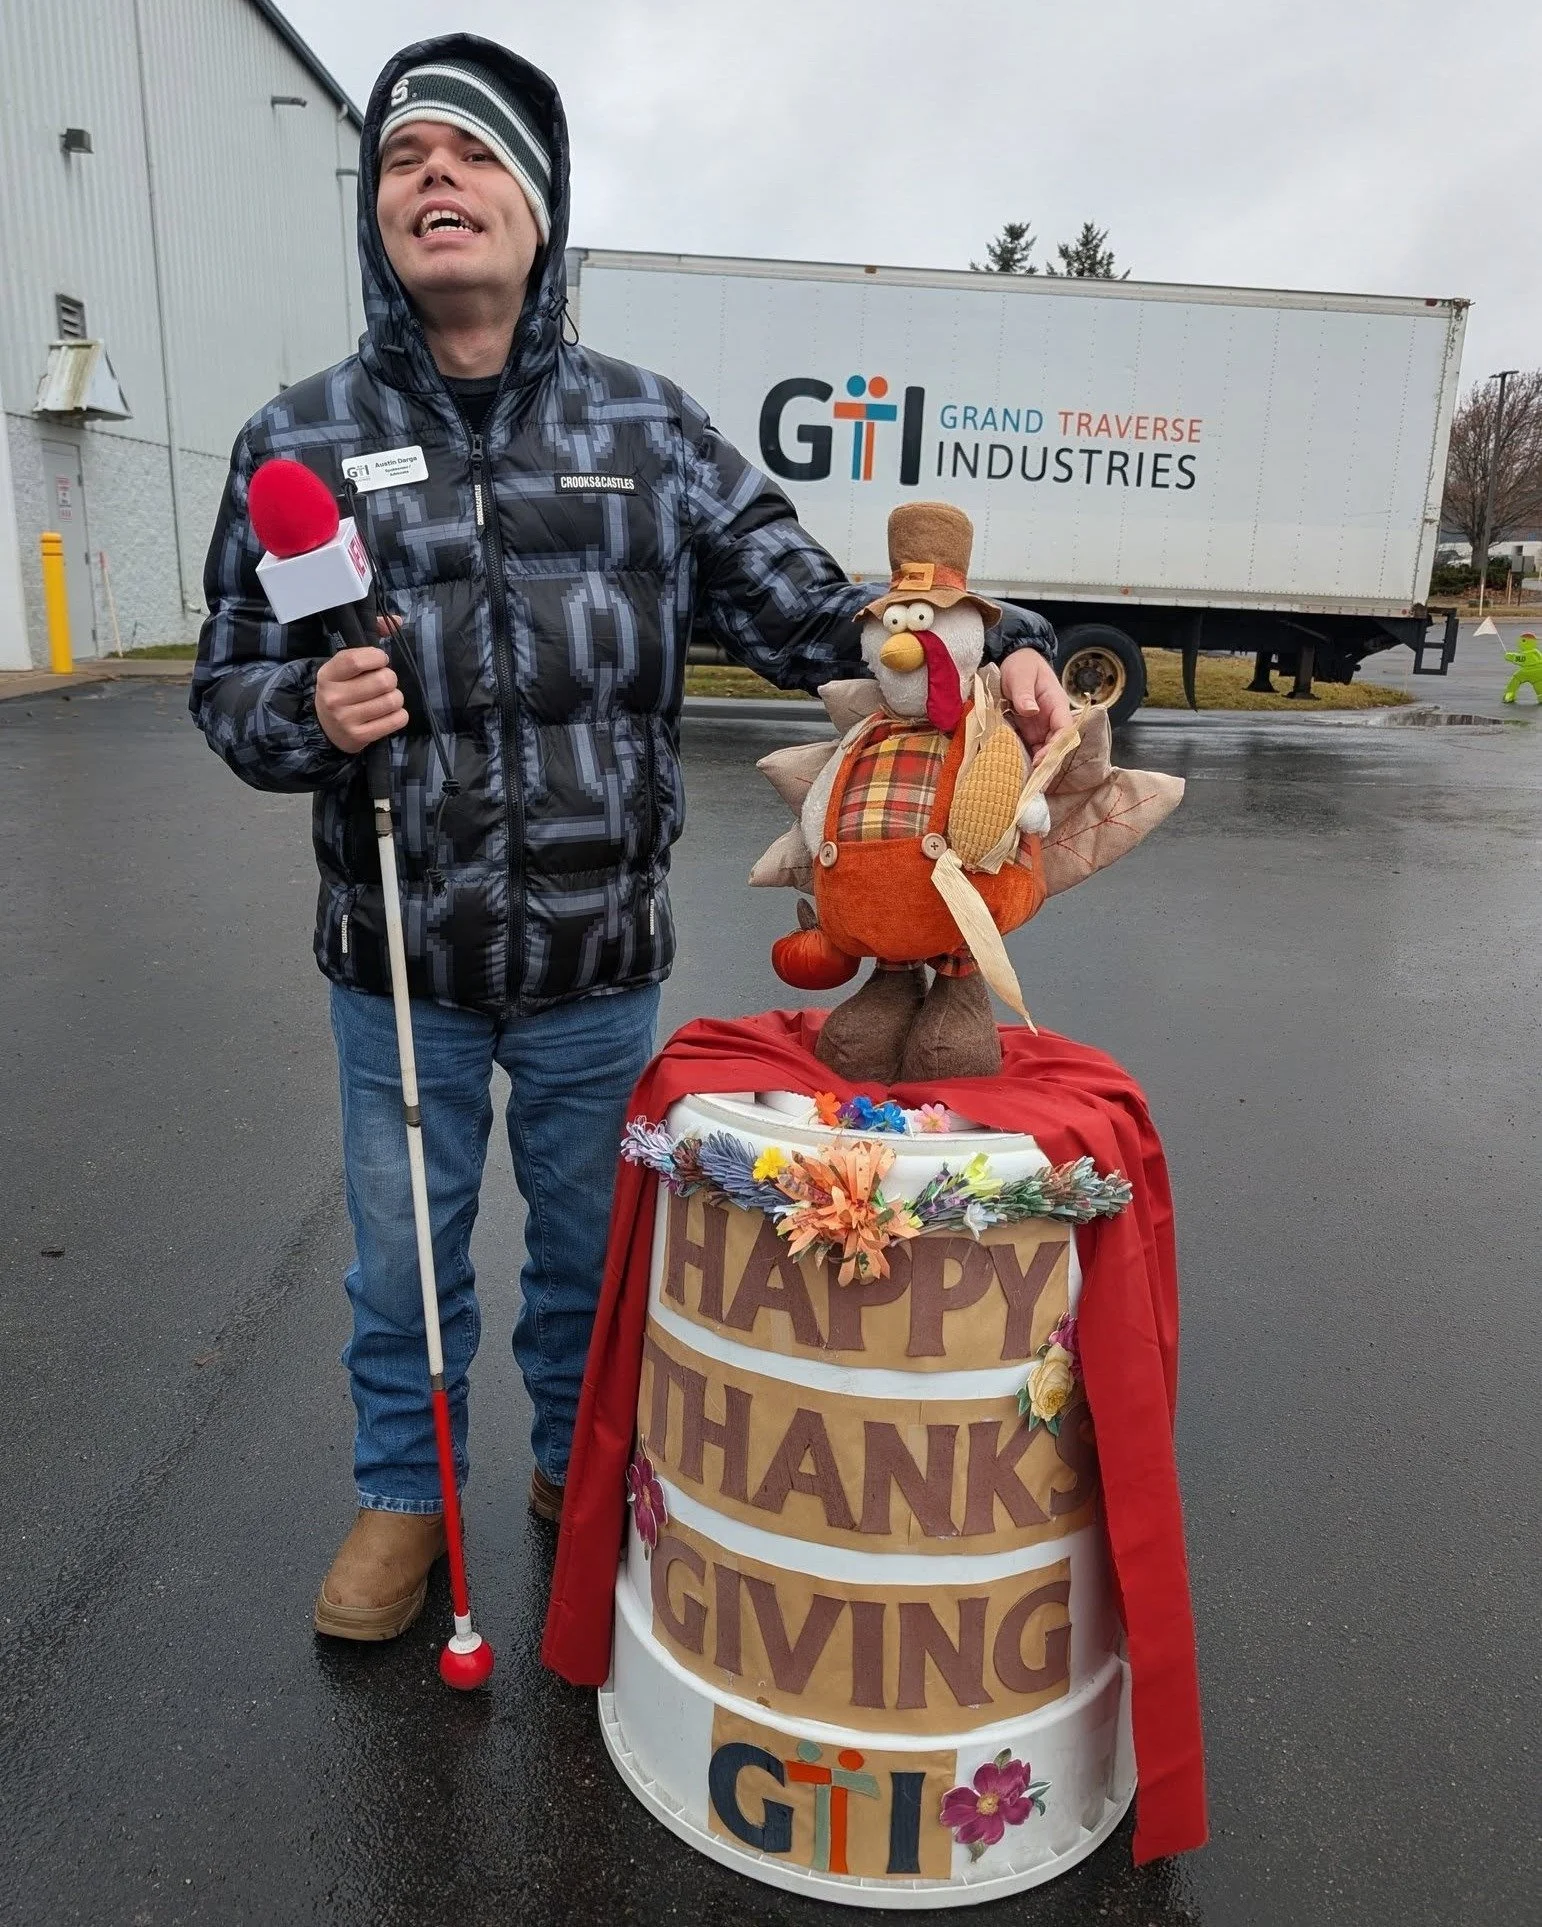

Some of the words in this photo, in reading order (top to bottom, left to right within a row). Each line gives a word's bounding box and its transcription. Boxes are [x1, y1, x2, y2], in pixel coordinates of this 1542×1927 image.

[391, 79, 409, 107] S
[940, 404, 1043, 434] GRAND
[1058, 411, 1203, 443] TRAVERSE
[375, 460, 397, 468] Austin
[560, 476, 634, 489] CROOKS&CASTLES
[936, 441, 1197, 490] INDUSTRIES
[665, 1192, 1069, 1361] HAPPY
[650, 1535, 1072, 1711] GIVING
